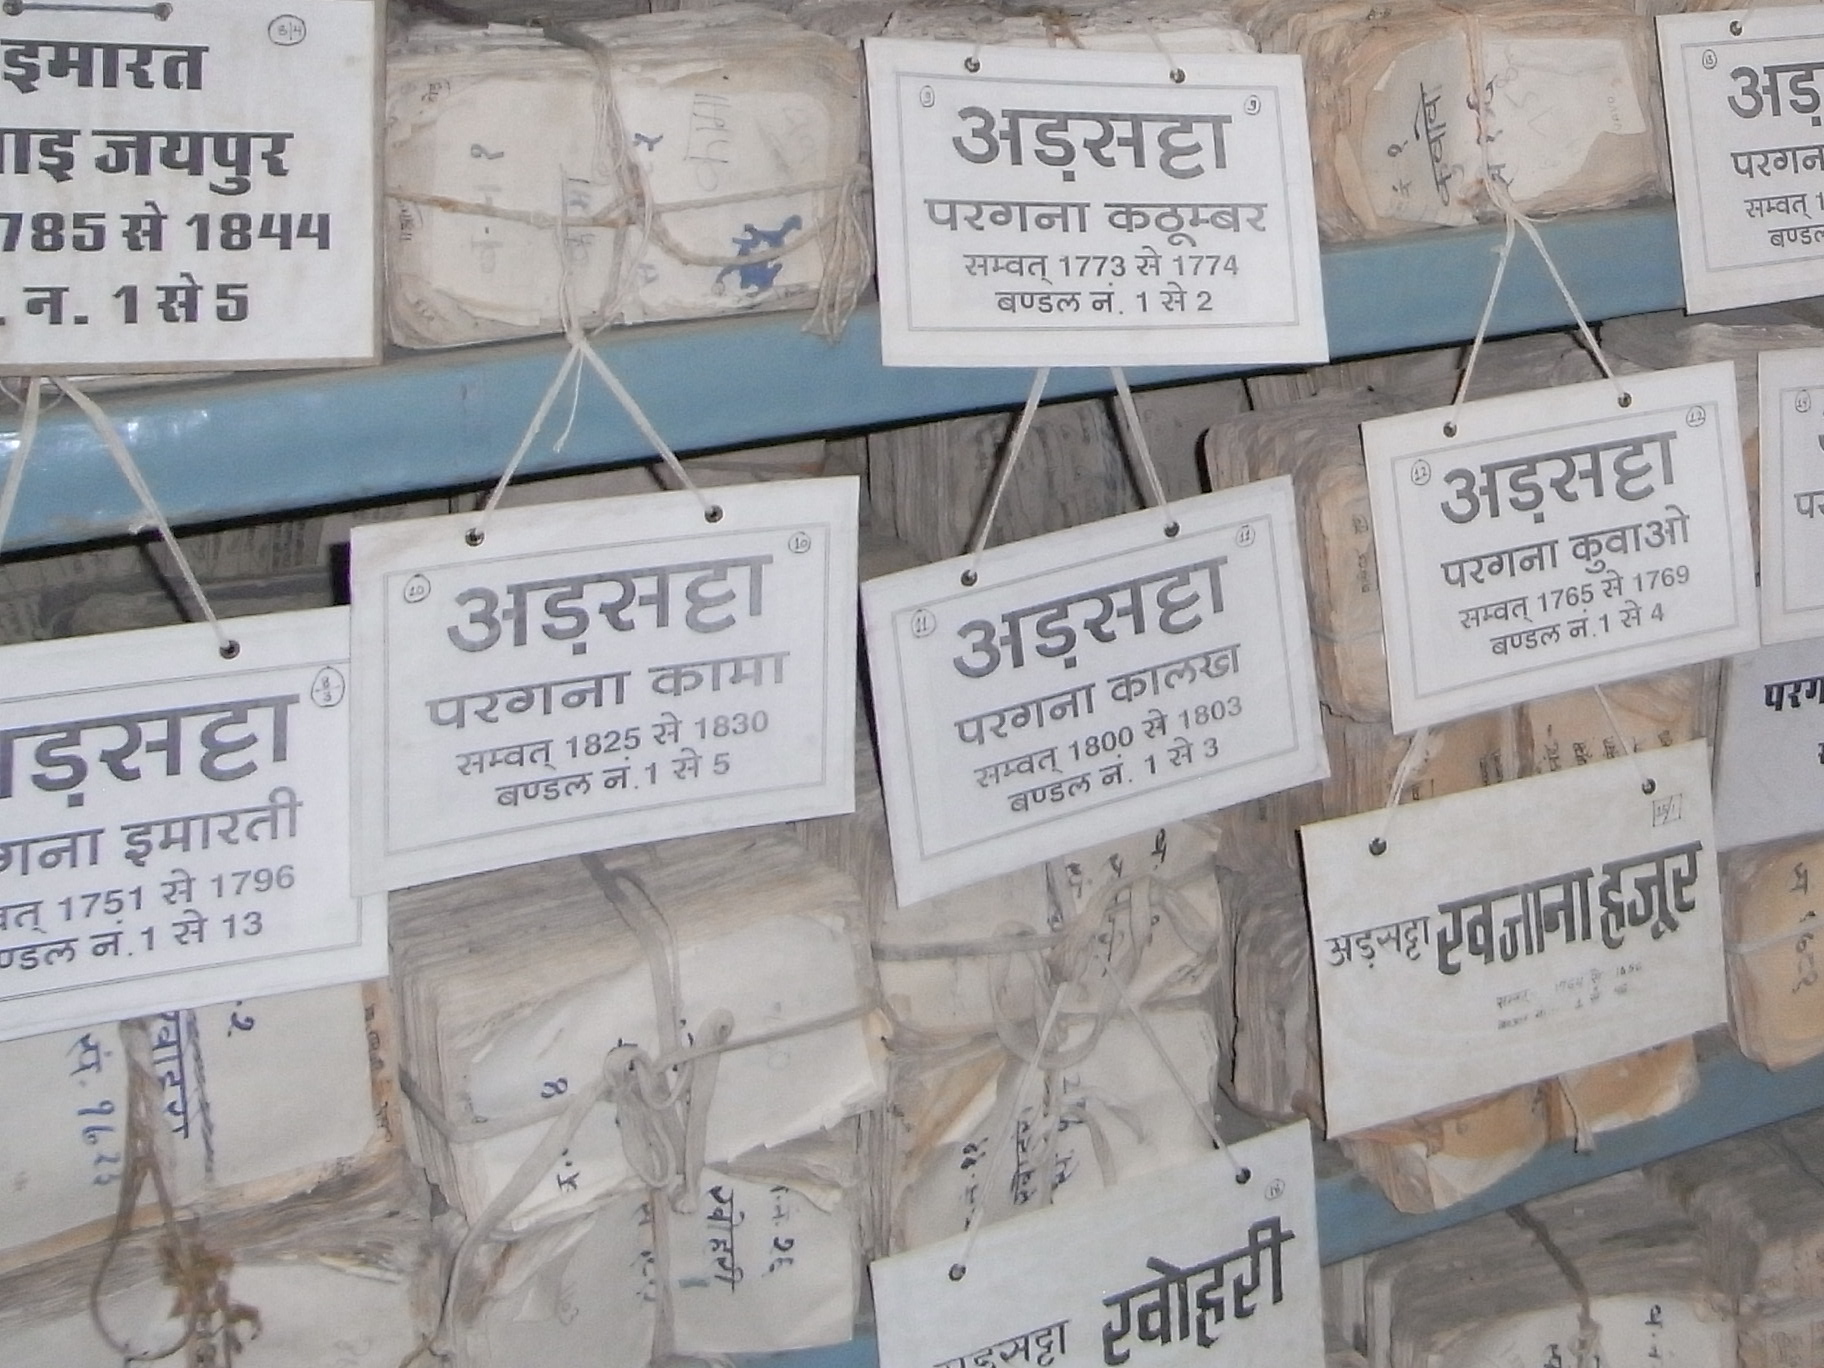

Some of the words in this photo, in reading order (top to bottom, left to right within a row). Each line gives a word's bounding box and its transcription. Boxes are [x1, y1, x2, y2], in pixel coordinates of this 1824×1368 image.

[0, 39, 209, 94] इमारत
[92, 129, 295, 196] जयपुर
[952, 105, 1232, 182] अड़सट्टा
[120, 200, 167, 252] से
[186, 212, 330, 252] 1844
[924, 198, 1090, 233] परगना
[1105, 203, 1267, 247] कठूम्बर
[1744, 194, 1811, 219] सम्वत्
[963, 254, 1052, 285] सम्वत्
[1058, 255, 1126, 277] 1773
[1136, 245, 1162, 276] से
[1172, 255, 1238, 276] 1774
[1440, 431, 1677, 525] अड़सट्टा
[1440, 539, 1559, 588] परगना
[1569, 505, 1690, 575] कुवाओ
[447, 554, 774, 656] अड़सट्टा
[952, 555, 1228, 678] अड़सट्टा
[1459, 595, 1531, 631] सम्वत्
[1537, 584, 1595, 614] 1765
[1602, 570, 1624, 599] से
[1634, 565, 1690, 593] 1769
[425, 670, 632, 730] परगना
[648, 651, 790, 697] कामा
[954, 682, 1096, 746] परगना
[455, 739, 556, 777] सम्वत्
[566, 728, 641, 759] 1825
[653, 711, 683, 746] से
[695, 710, 769, 740] 1830
[974, 746, 1062, 789] सम्वत्
[1069, 725, 1134, 762] 1800
[1142, 709, 1166, 741] से
[1178, 696, 1243, 730] 1803
[0, 828, 104, 876] गना
[121, 786, 303, 868] इमारती
[58, 886, 142, 921] 1751
[161, 868, 196, 904] से
[211, 864, 295, 899] 1796
[1437, 867, 1594, 976] खजाना
[1598, 840, 1703, 950] हजूर
[1102, 1216, 1295, 1367] खोहरी
